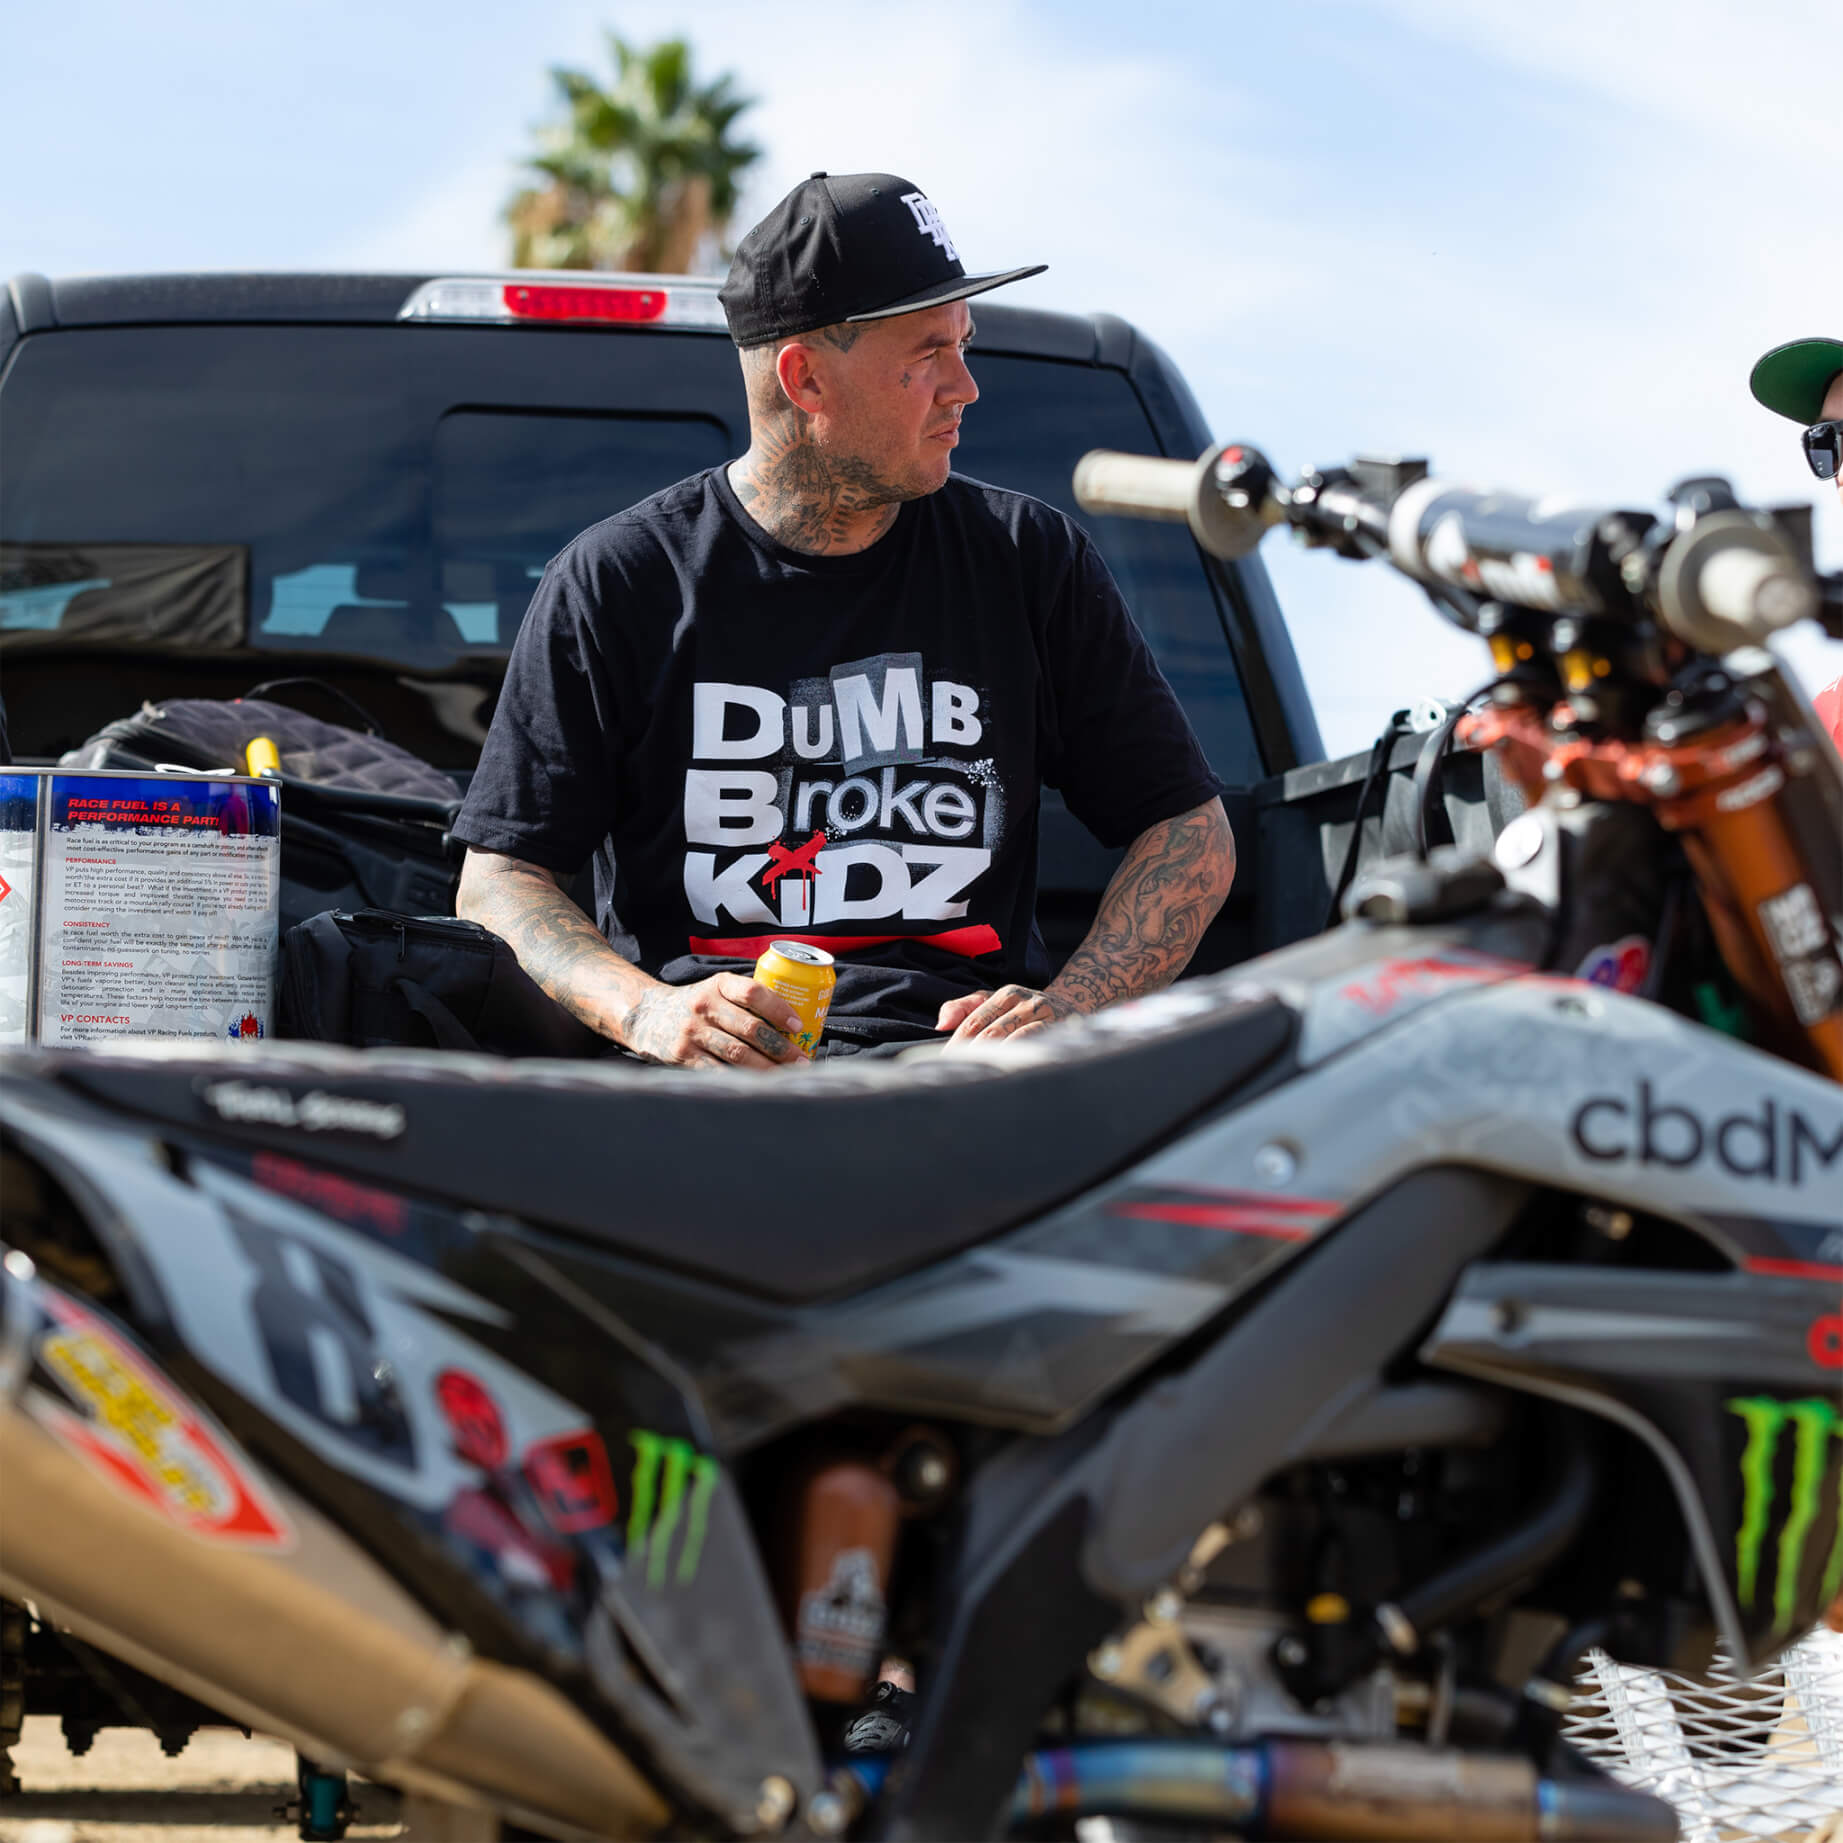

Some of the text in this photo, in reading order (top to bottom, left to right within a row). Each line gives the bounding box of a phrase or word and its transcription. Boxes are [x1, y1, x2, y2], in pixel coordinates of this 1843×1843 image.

[68, 798, 180, 812] RACE FUEL IS A
[683, 766, 977, 847] Broke
[68, 812, 220, 826] PERFORMANCE PART!
[126, 847, 164, 856] performance
[166, 848, 182, 857] gains
[200, 850, 212, 858] part
[75, 866, 89, 874] puts
[91, 866, 104, 875] high
[105, 867, 147, 877] performance,
[148, 869, 168, 878] quality
[141, 876, 167, 885] provides
[98, 882, 125, 892] personal
[99, 890, 120, 899] torque
[140, 892, 169, 901] improved
[92, 905, 115, 914] making
[159, 900, 172, 909] rally
[175, 933, 188, 942] gain
[146, 940, 167, 949] exactly
[88, 969, 119, 979] improving
[95, 977, 122, 986] vaporize
[102, 985, 135, 995] protection
[95, 1001, 117, 1010] engine
[60, 1014, 130, 1024] VP CONTACTS
[158, 1029, 178, 1038] Racing
